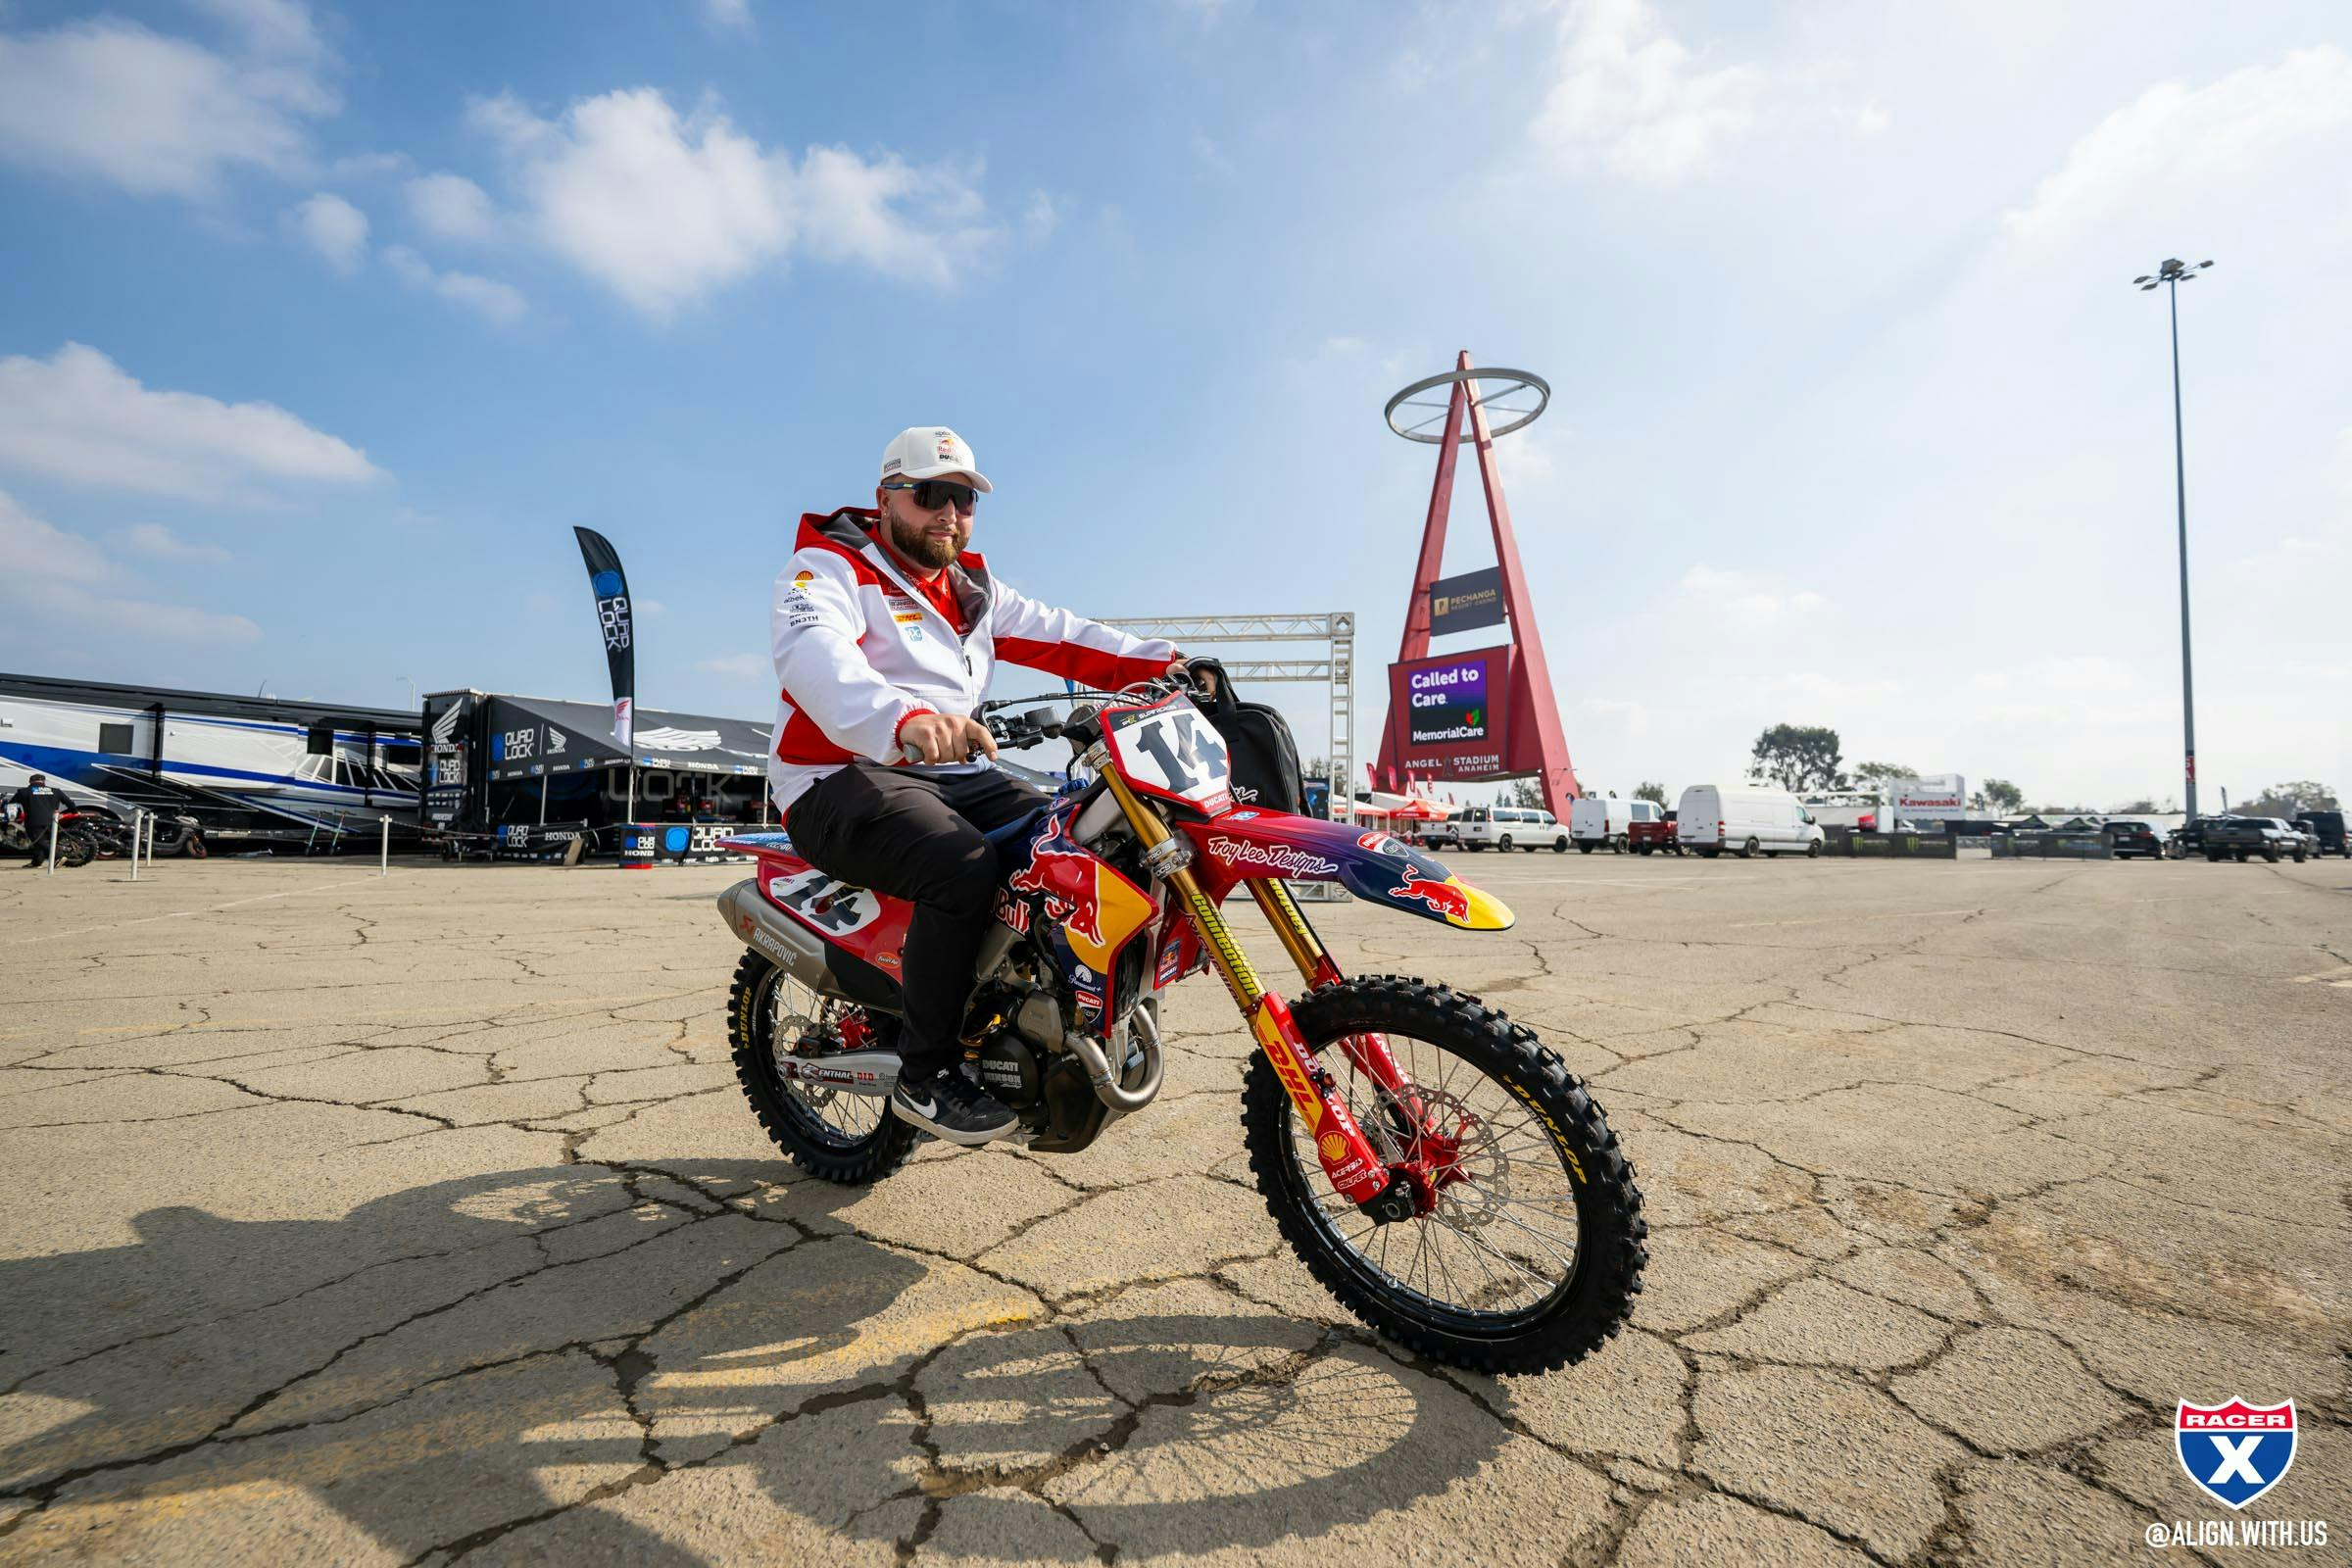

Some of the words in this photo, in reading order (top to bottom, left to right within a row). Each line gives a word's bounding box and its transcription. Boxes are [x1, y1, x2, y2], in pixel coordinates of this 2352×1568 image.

[1450, 589, 1496, 605] PECHANGA
[598, 599, 622, 651] LOCK
[612, 597, 630, 649] QUAD
[1411, 668, 1458, 689] Called
[1461, 667, 1479, 682] to
[505, 728, 534, 746] QUAD
[1412, 726, 1485, 742] MemorialCare
[431, 744, 461, 753] OND
[505, 744, 534, 760] LOCK
[1135, 712, 1228, 794] 14
[439, 760, 461, 771] QUAD
[688, 761, 719, 770] HONDA
[1405, 759, 1443, 768] ANGEL
[1453, 755, 1499, 764] STADIUM
[1458, 763, 1499, 772] ANAHEIM
[439, 771, 461, 783] LOCK
[1203, 794, 1229, 808] DUCATI
[1899, 798, 1961, 807] Kawasaki
[508, 825, 529, 836] QUAD
[545, 831, 581, 841] HONDA
[507, 836, 529, 848] LOCK
[1208, 836, 1241, 866] Troy
[1237, 840, 1268, 863] Lee
[1266, 845, 1338, 878] Designs
[1155, 862, 1172, 877] OCS
[995, 887, 1030, 936] Bull
[1078, 994, 1100, 1006] DUCATI
[739, 986, 753, 1042] DUNLOP
[982, 1059, 1019, 1072] DUCATI
[1263, 1041, 1314, 1112] DHL
[1293, 1042, 1356, 1138] DULOP
[1511, 1084, 1588, 1185] DUNLOP
[1331, 1158, 1364, 1179] ACERBIS
